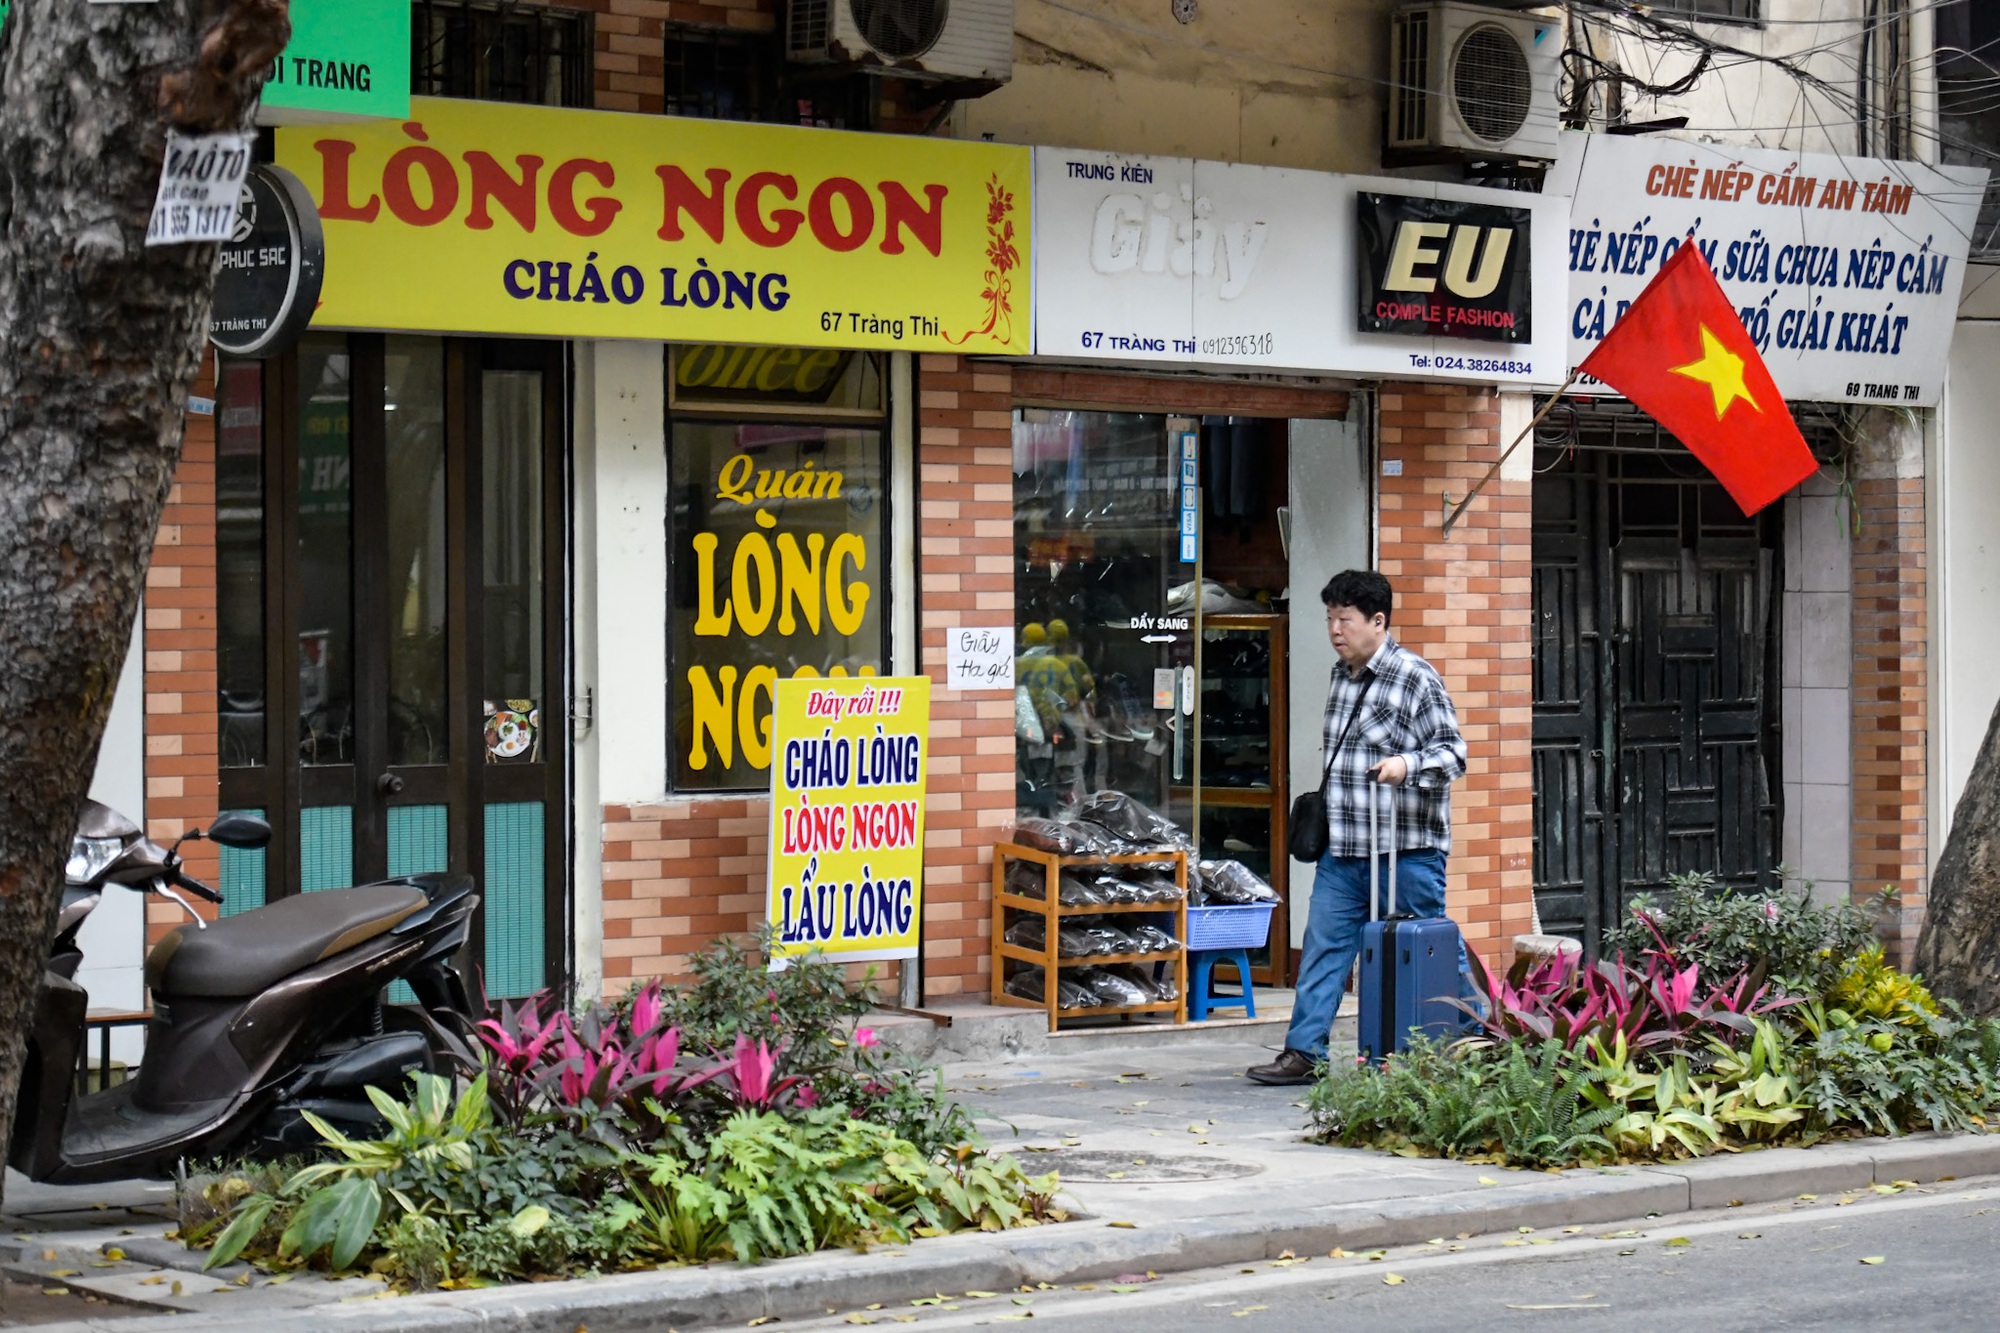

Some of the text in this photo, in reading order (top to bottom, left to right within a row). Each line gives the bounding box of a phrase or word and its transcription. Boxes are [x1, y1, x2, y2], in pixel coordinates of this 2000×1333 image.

[292, 57, 371, 93] TRANG
[313, 121, 949, 258] LÒNG NGON
[1065, 161, 1115, 181] TRUNG
[1645, 158, 1914, 216] CHÈ NẾP CẨM AN TÂM
[503, 251, 791, 312] CHÁO LÒNG
[1382, 220, 1514, 299] EU
[1601, 215, 1659, 275] NẾP
[1723, 228, 1771, 284] SỮA
[1775, 244, 1839, 288] CHUA
[1896, 233, 1949, 295] CẨM
[820, 312, 939, 340] 67 Tràng Thi
[1375, 301, 1515, 329] COMPLE FASHION
[1776, 295, 1835, 350] GIẢI
[1834, 302, 1909, 355] KHÁT
[1081, 331, 1104, 349] 67
[1108, 333, 1165, 352] TRÀNG
[1202, 332, 1274, 356] 0912396318
[1409, 354, 1533, 374] Tel: 024.38264834
[1845, 382, 1920, 400] 69 TRANG THI
[716, 454, 844, 505] Quán
[692, 508, 870, 638] LÒNG
[1130, 612, 1189, 630] ĐẨY SANG
[807, 685, 902, 722] Đây rồi !!!
[785, 725, 919, 789] CHÁO LÒNG
[783, 794, 918, 854] LÒNG NGON
[781, 856, 913, 943] LẨU LÒNG
